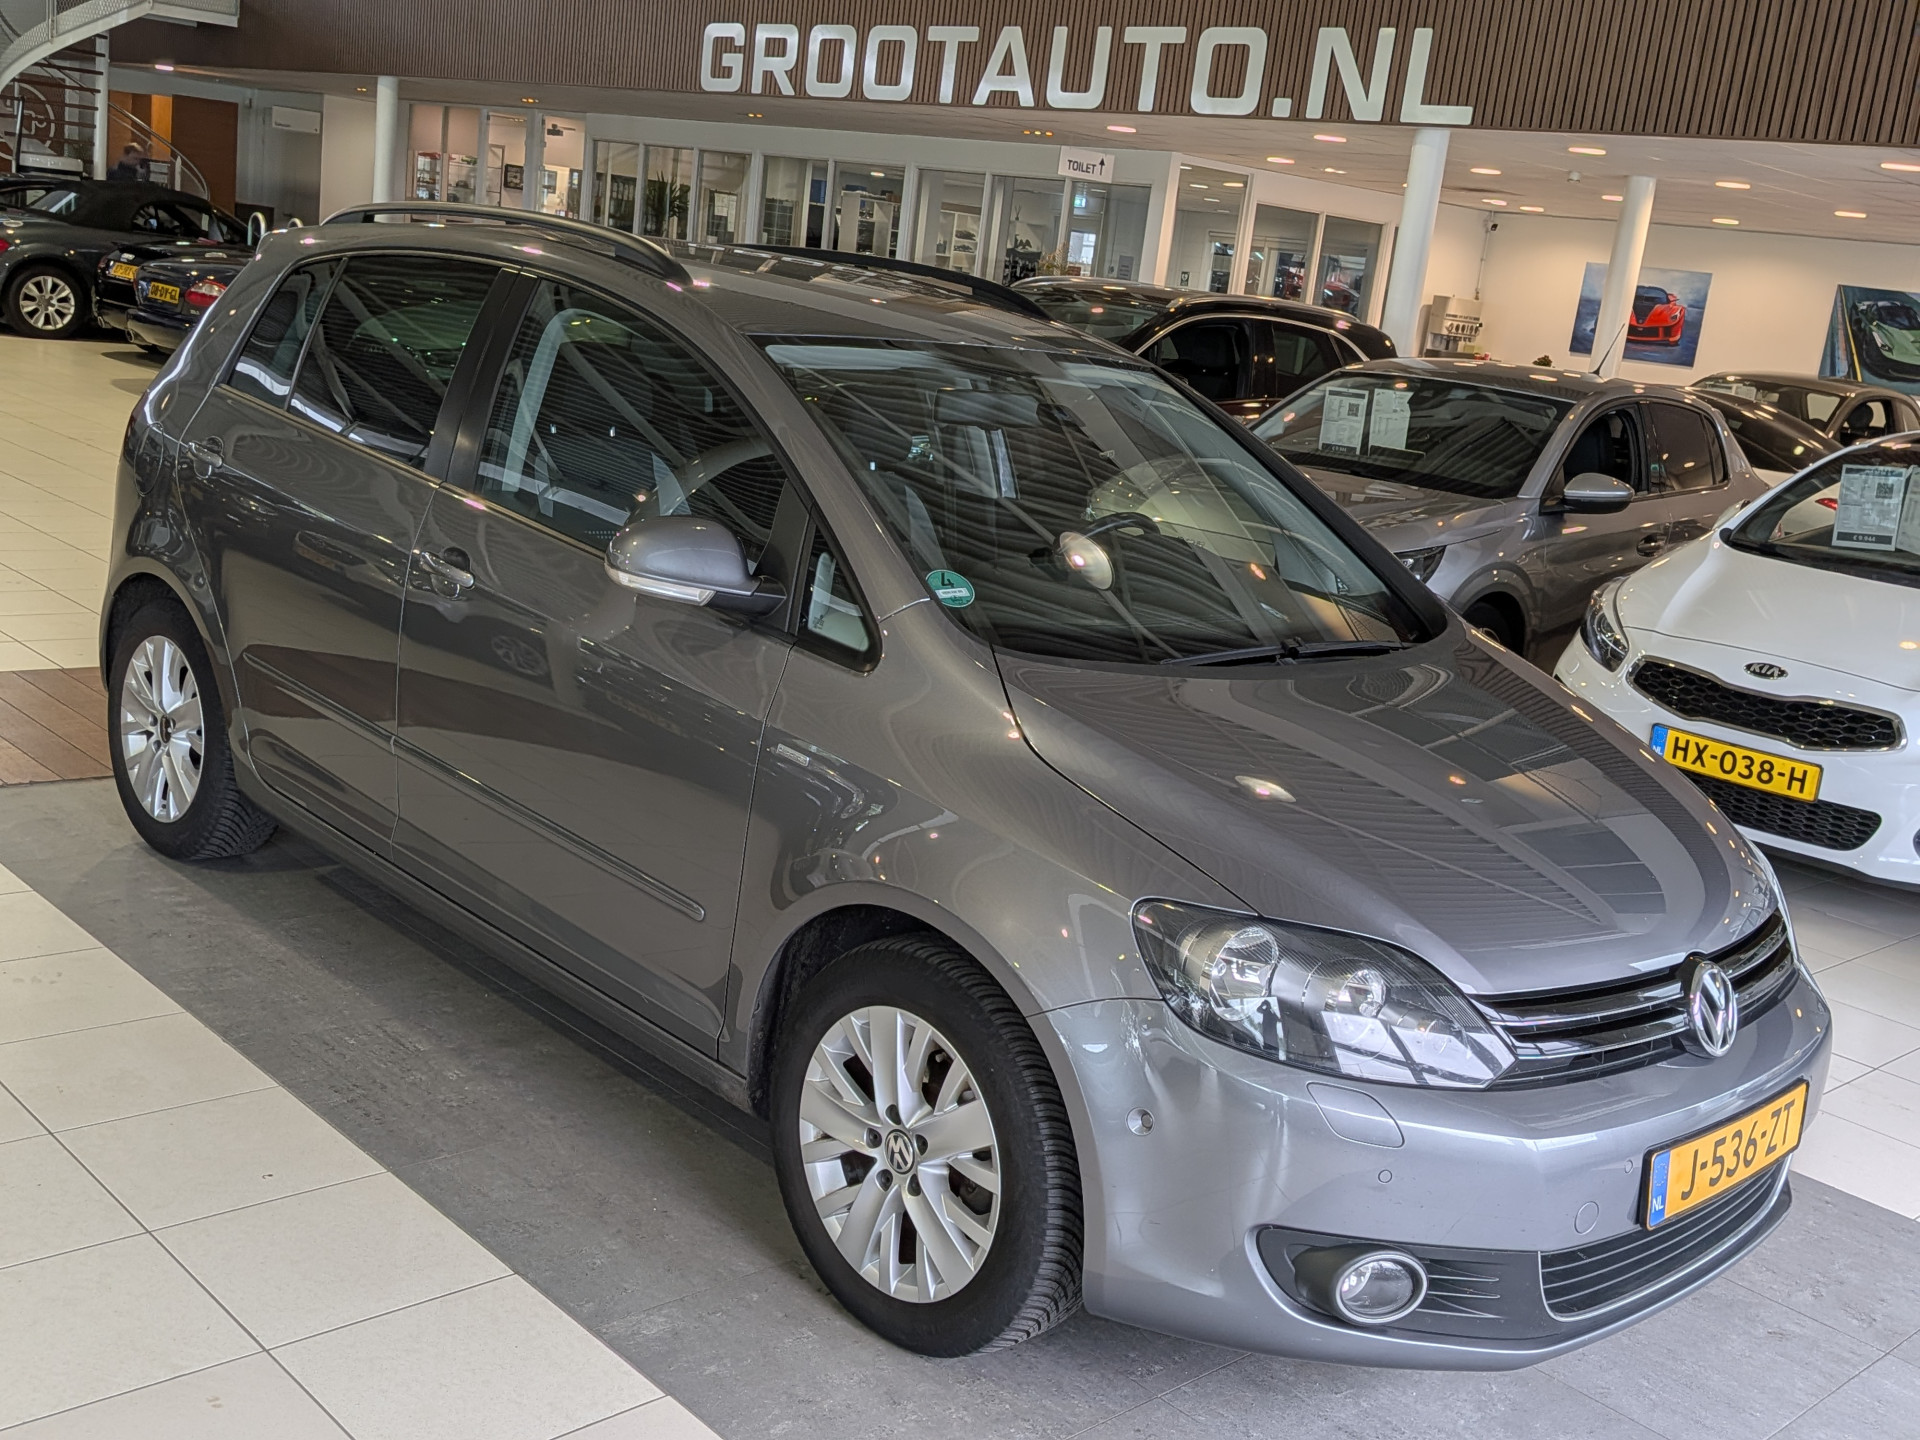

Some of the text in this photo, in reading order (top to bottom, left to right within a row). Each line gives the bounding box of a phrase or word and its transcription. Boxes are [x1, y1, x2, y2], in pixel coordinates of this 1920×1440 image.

[700, 22, 1473, 126] GROOTAUTO.NL
[1067, 159, 1097, 174] TOILET
[1750, 663, 1781, 676] KIA
[1671, 736, 1808, 794] HX-038-H
[1651, 1098, 1795, 1213] NL J-536-ZT
